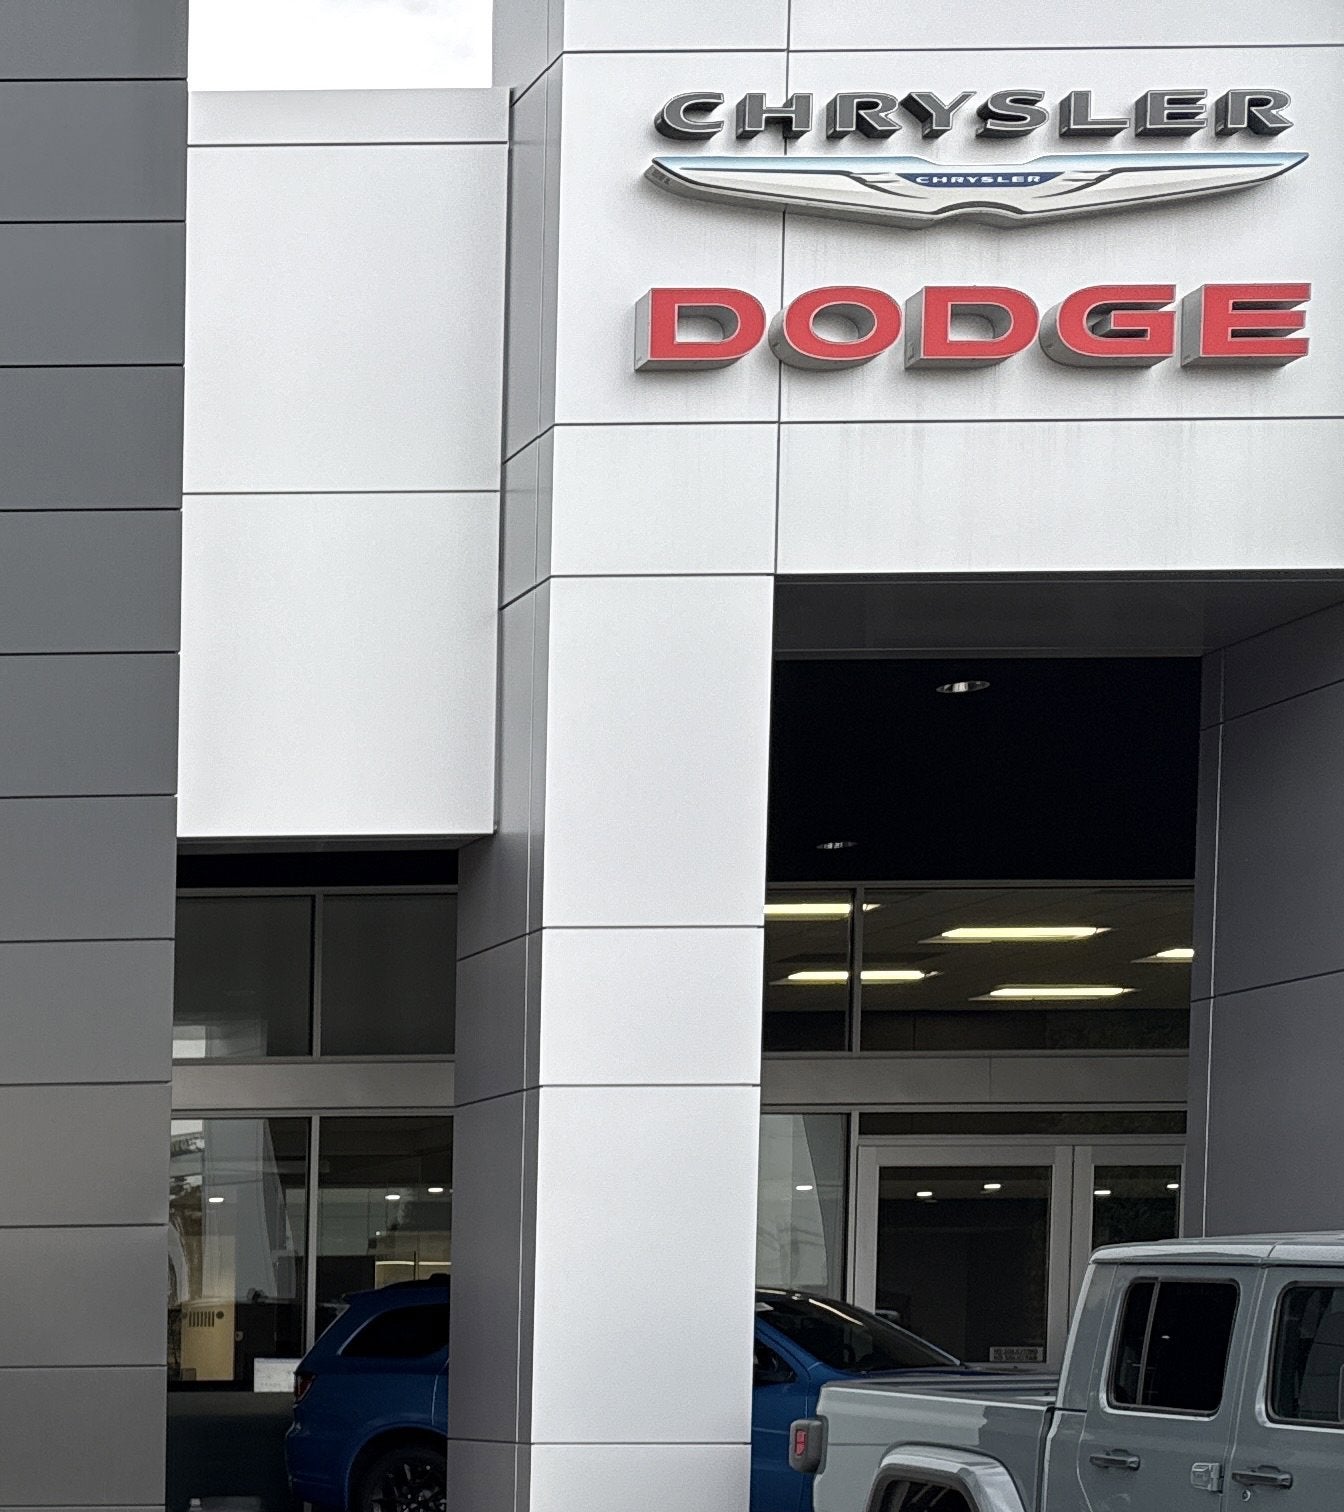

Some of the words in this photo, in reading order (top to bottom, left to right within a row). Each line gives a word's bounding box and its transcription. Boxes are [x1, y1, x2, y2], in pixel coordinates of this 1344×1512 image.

[654, 88, 1295, 141] CHRYSLER
[915, 175, 1041, 184] CHRYSLER
[635, 282, 1312, 371] DODGE
